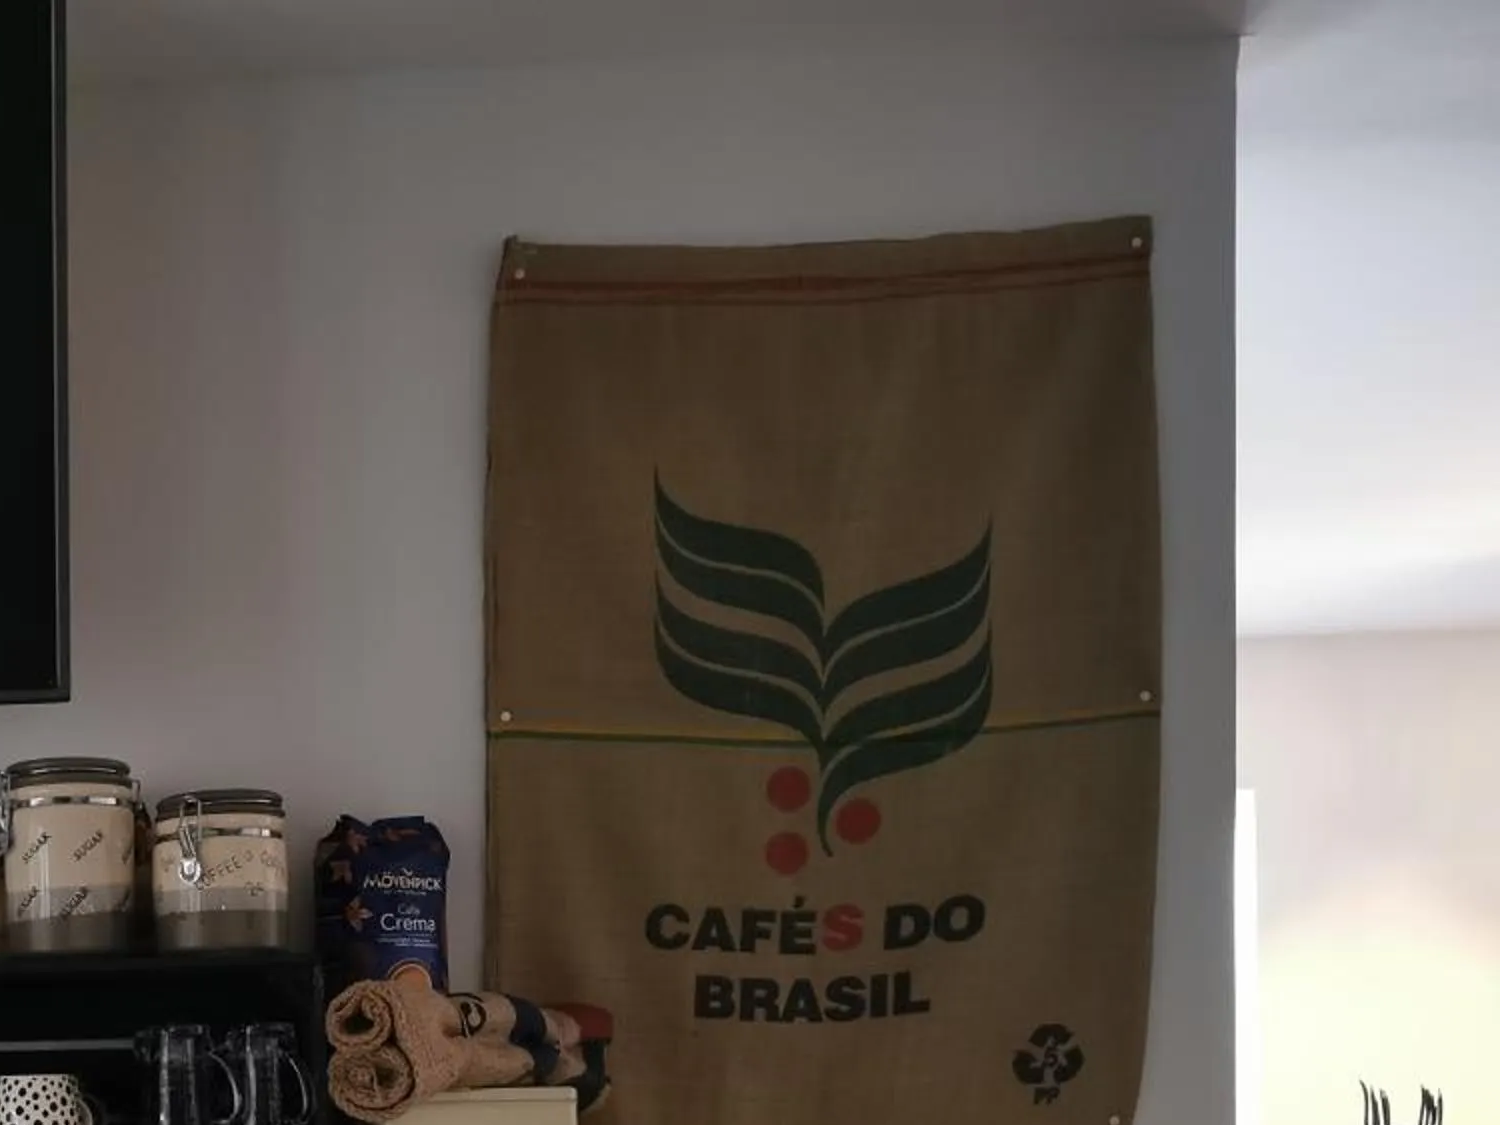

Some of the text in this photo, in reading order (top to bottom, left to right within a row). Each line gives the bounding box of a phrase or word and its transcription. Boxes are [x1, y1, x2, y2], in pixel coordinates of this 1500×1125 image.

[380, 913, 437, 931] Crema
[644, 894, 986, 955] CAFÉS DO
[693, 970, 932, 1024] BRASIL
